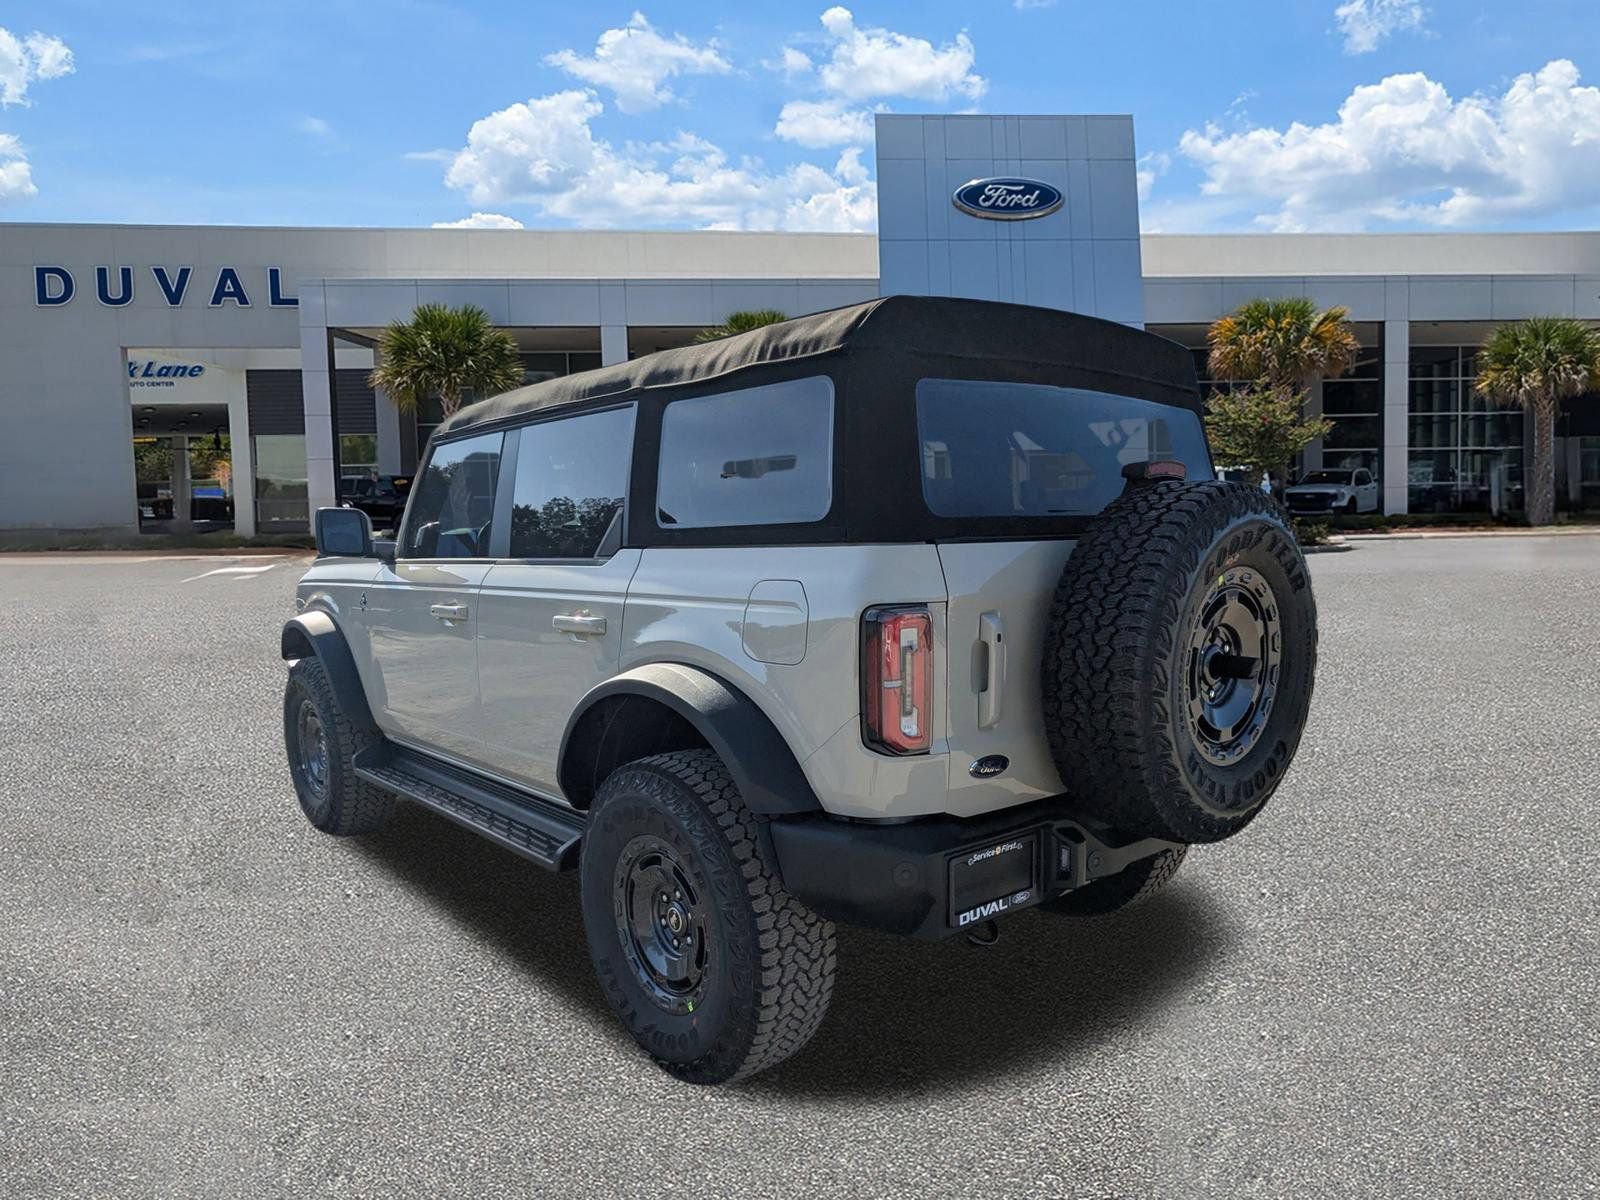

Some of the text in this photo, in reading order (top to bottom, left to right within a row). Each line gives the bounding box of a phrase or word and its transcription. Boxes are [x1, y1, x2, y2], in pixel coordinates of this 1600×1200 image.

[979, 185, 1040, 207] Ford
[34, 265, 299, 307] DUVAL
[142, 361, 204, 378] Lane
[973, 842, 1017, 862] Service First
[959, 899, 1008, 926] DUVAL
